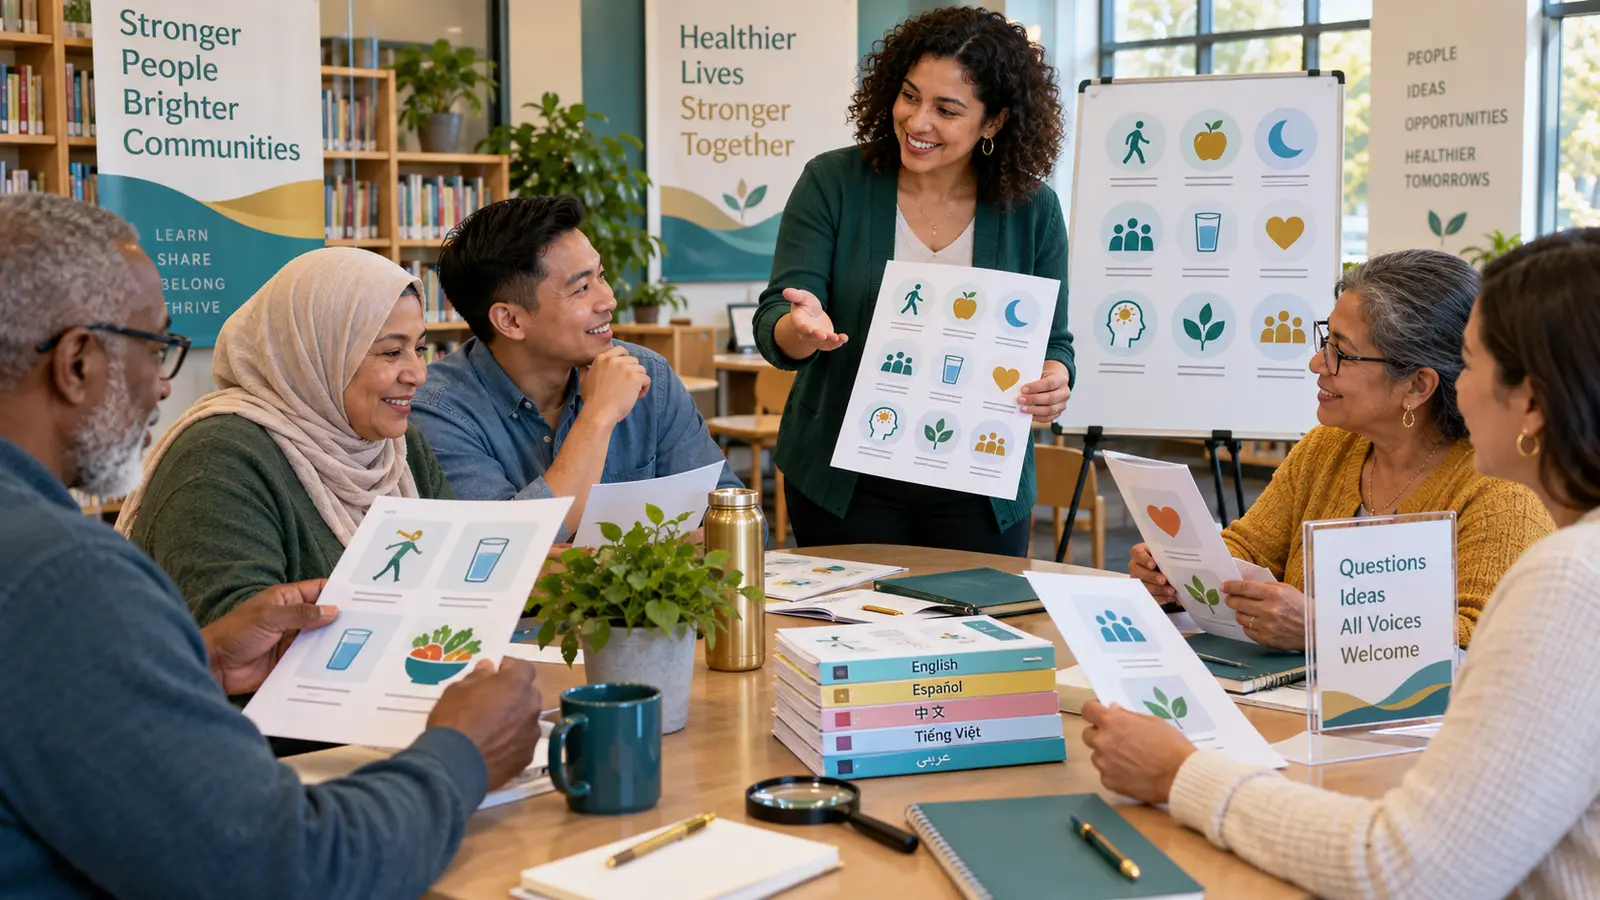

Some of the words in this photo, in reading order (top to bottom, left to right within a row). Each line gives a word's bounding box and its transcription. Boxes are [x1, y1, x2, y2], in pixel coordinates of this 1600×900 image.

[119, 9, 242, 51] Stronger
[680, 24, 797, 50] Healthier
[1407, 46, 1457, 66] PEOPLE
[122, 49, 218, 86] People
[681, 60, 744, 85] Lives
[1407, 81, 1446, 98] IDEAS
[123, 88, 239, 125] Brighter
[681, 95, 791, 128] Stronger
[1405, 109, 1508, 131] OPPORTUNITIES
[123, 128, 301, 161] Communities
[680, 132, 795, 163] Together
[1405, 147, 1476, 164] HEALTHIER
[1405, 172, 1490, 189] TOMORROWS
[155, 228, 208, 242] LEARN
[157, 252, 211, 266] SHARE
[164, 300, 221, 314] HRIVE
[1339, 554, 1427, 578] Questions
[1340, 587, 1386, 606] Ideas
[1340, 616, 1362, 635] All
[1367, 613, 1422, 633] Voices
[1340, 643, 1420, 664] Welcome
[912, 658, 958, 675] English
[912, 680, 962, 698] Español
[914, 705, 945, 720] 中文
[914, 728, 952, 743] Tiếng
